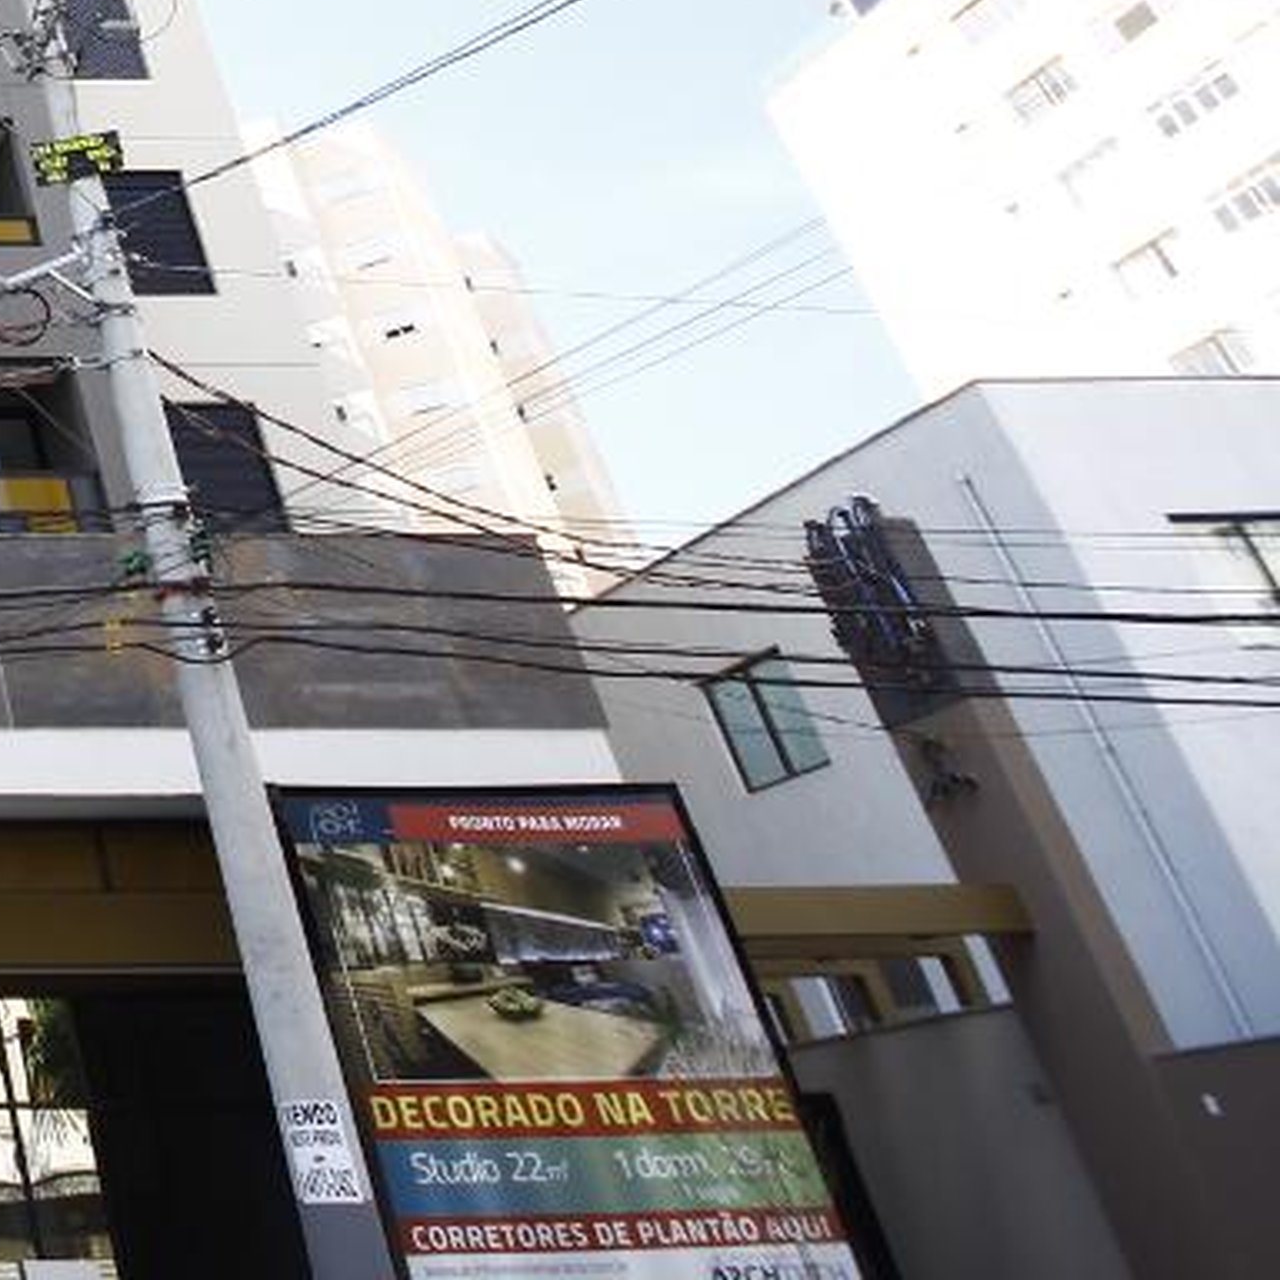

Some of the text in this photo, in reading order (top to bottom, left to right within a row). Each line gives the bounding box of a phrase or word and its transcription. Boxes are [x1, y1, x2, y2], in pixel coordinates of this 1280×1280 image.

[371, 1087, 797, 1130] DECORADO NA TORRE
[410, 1151, 501, 1185] Studio
[412, 1210, 834, 1251] CORRETORES DE PLANTÃO AQUI
